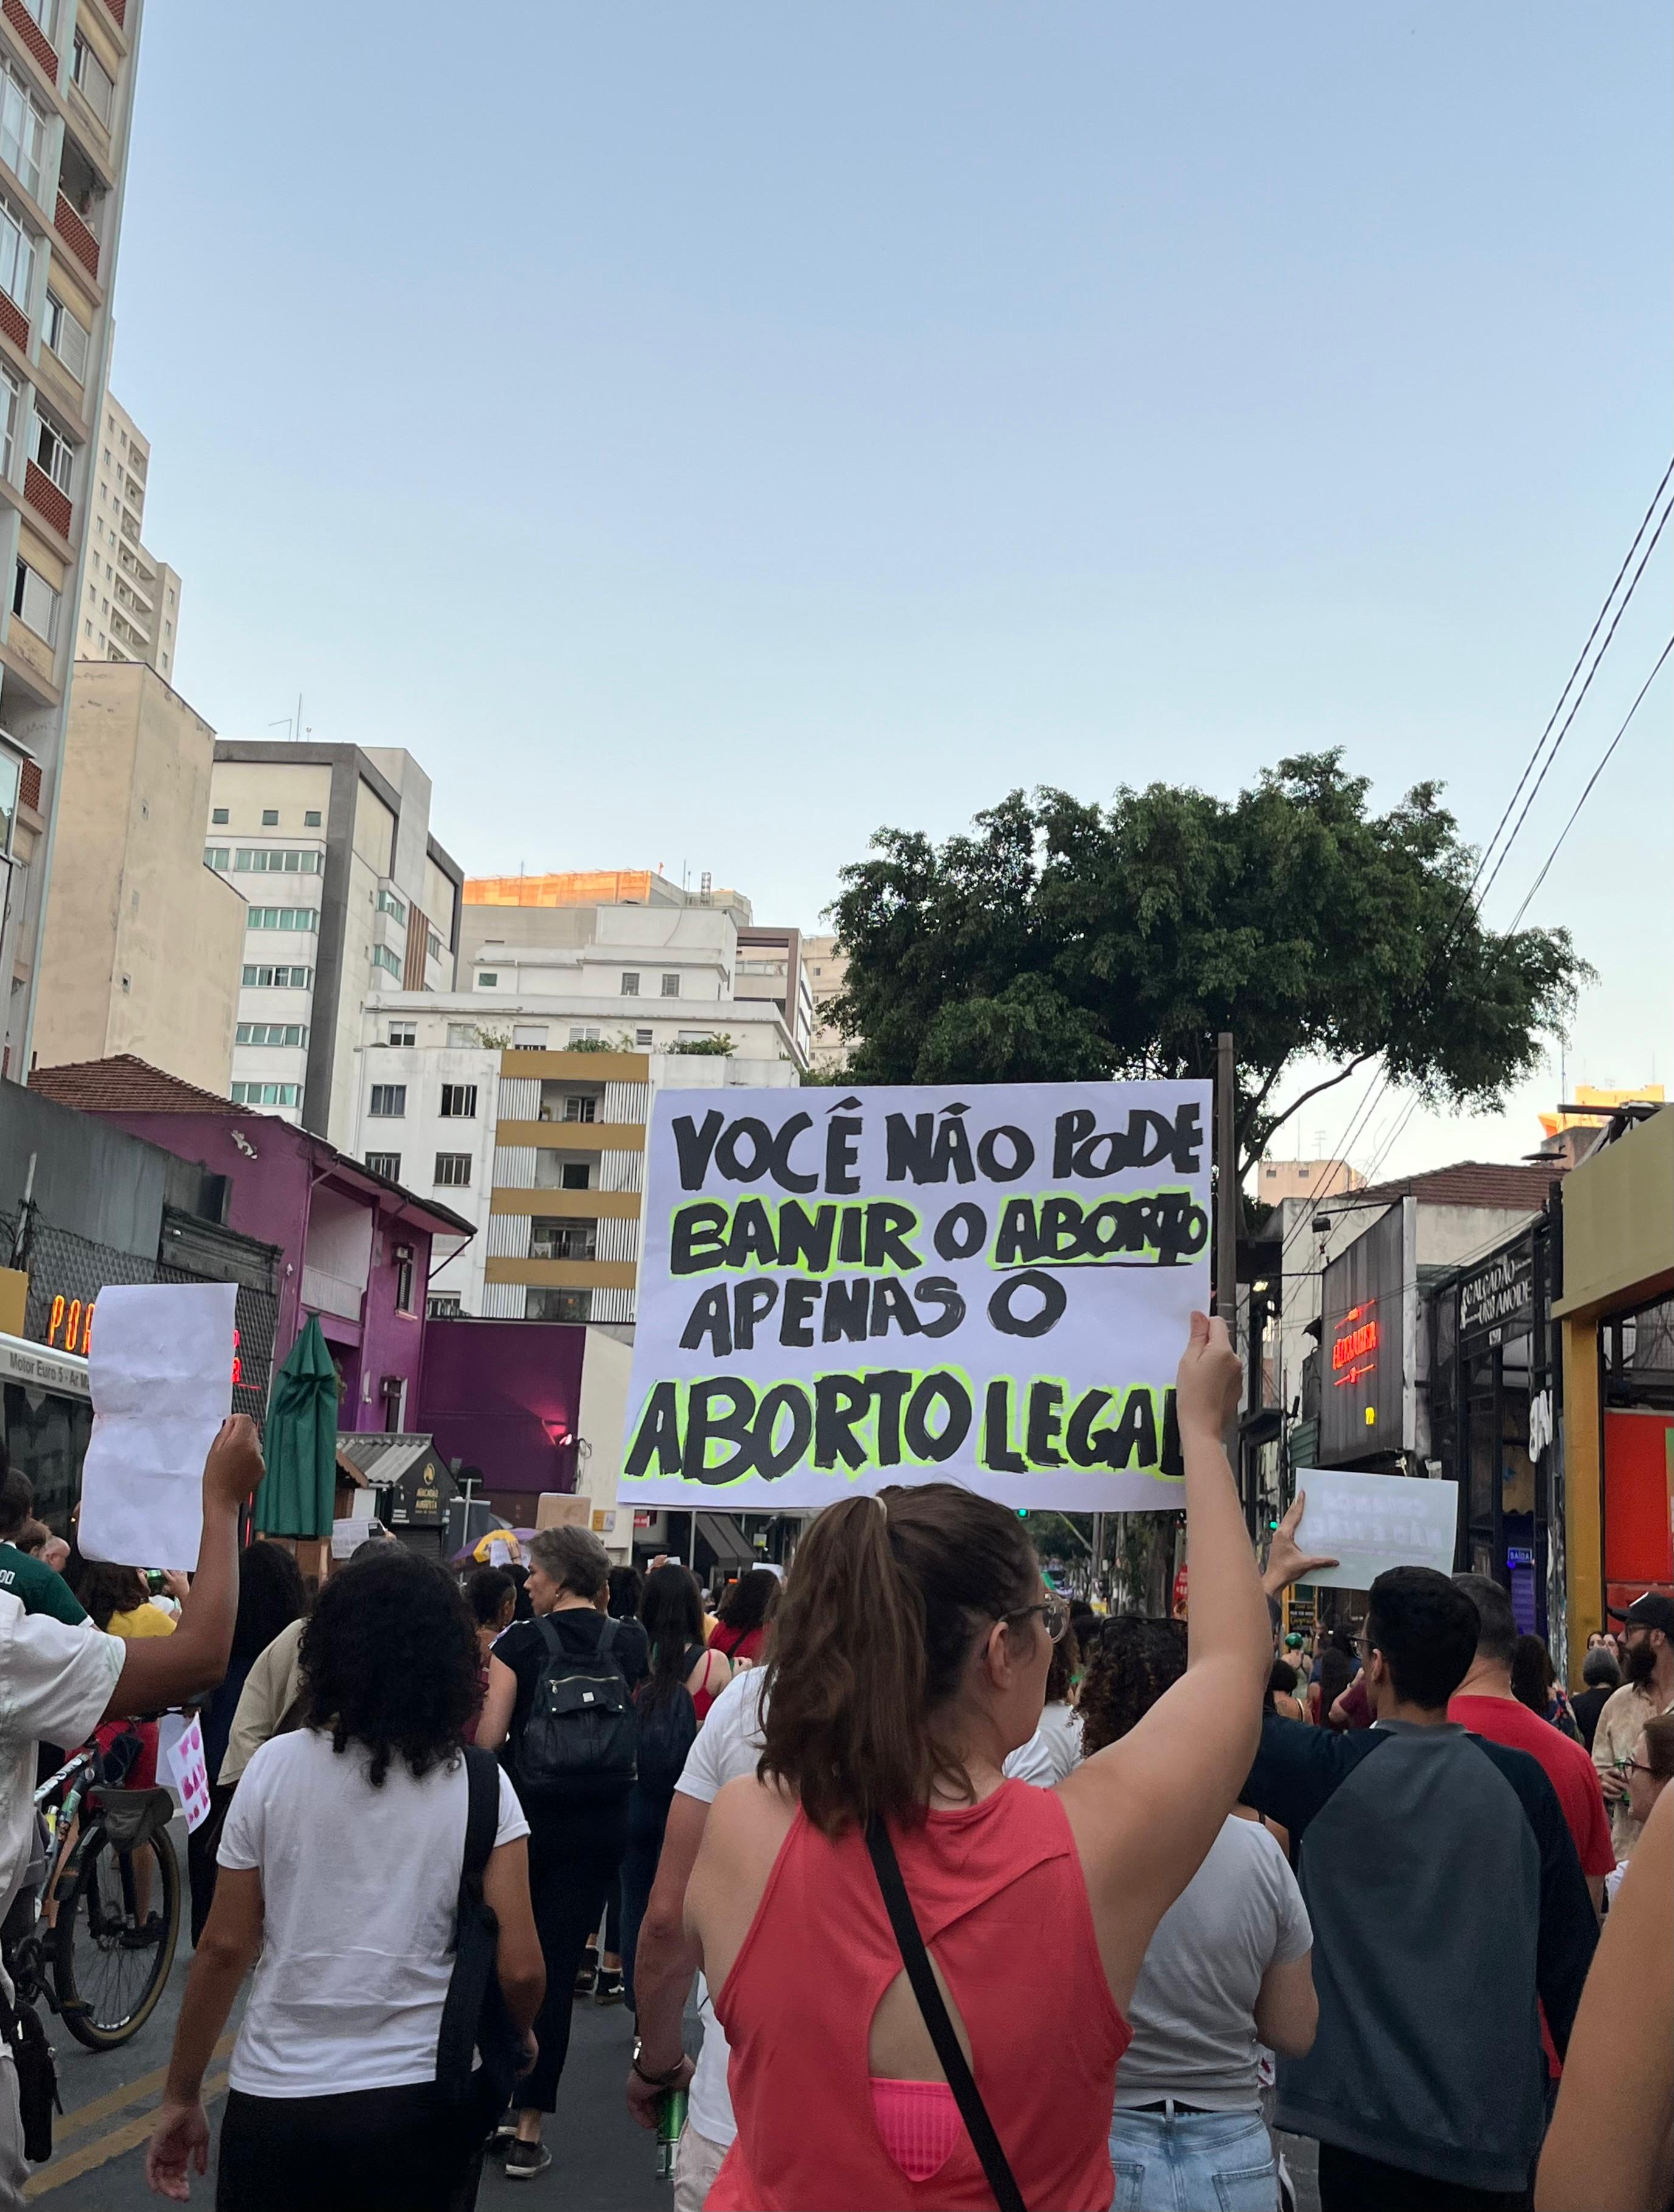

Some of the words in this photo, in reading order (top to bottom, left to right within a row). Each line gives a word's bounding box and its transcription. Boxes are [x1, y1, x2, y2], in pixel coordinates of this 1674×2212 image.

[671, 1095, 863, 1194] VOCÊ
[1052, 1102, 1203, 1179] PODE
[670, 1198, 922, 1274] BANIR
[933, 1202, 987, 1261] O
[995, 1191, 1209, 1264] ABORTO
[679, 1275, 966, 1357] APENAS
[988, 1269, 1068, 1338] O
[10, 1352, 35, 1375] Motor
[37, 1359, 56, 1381] Euro
[58, 1367, 63, 1382] 5
[624, 1370, 972, 1485] ABORTO
